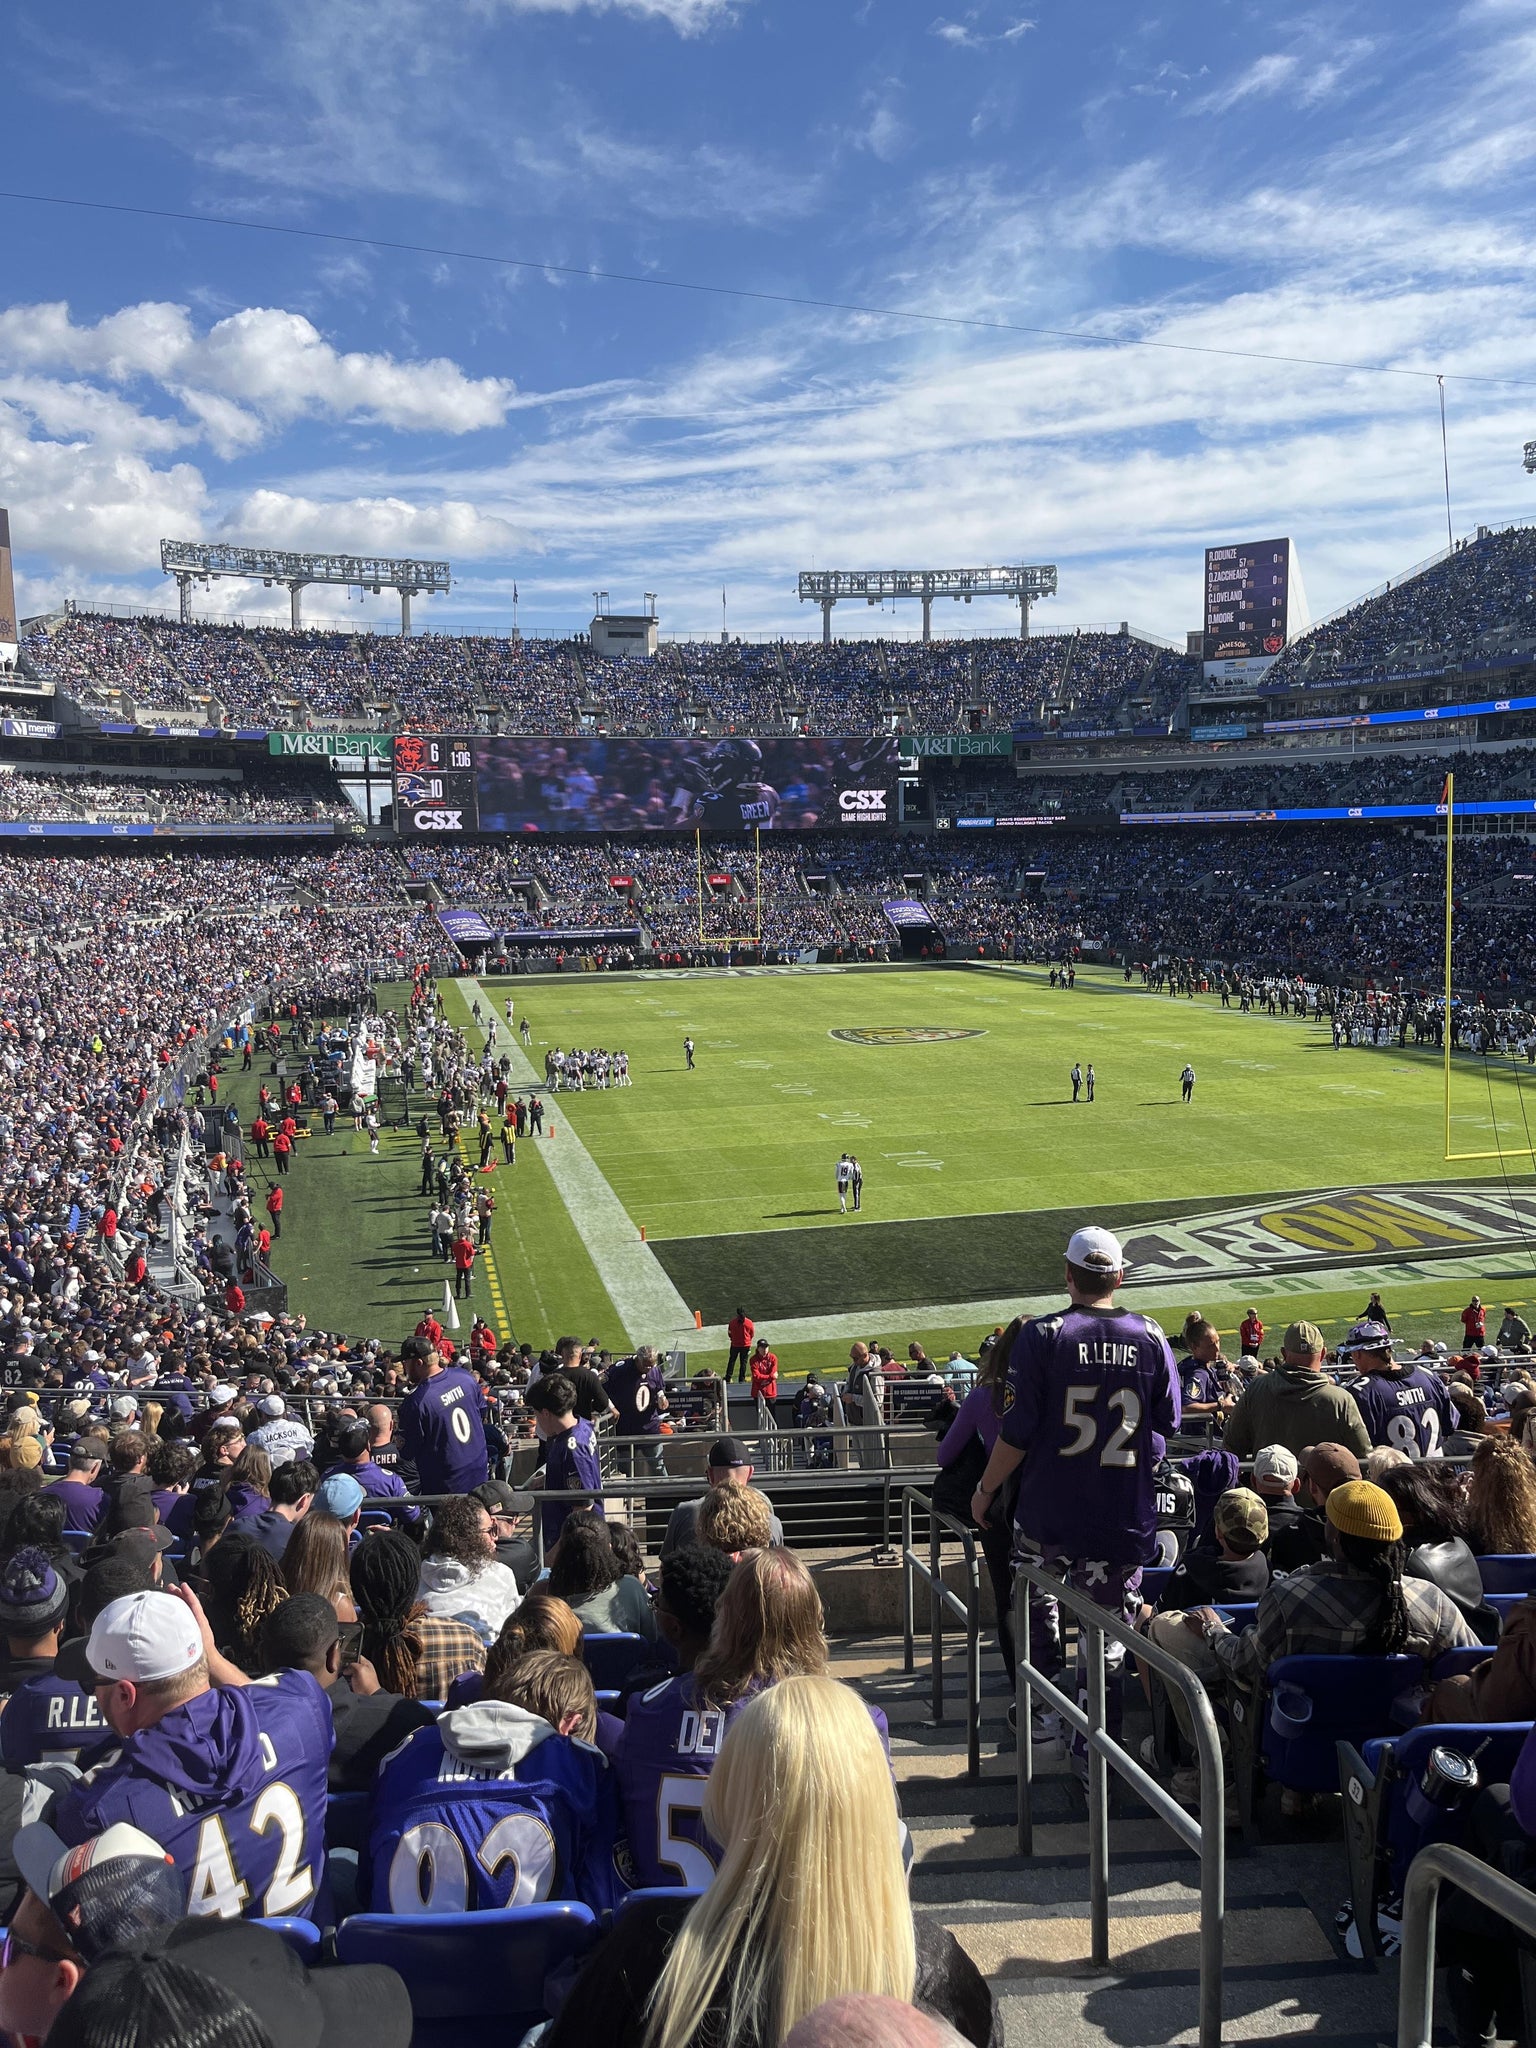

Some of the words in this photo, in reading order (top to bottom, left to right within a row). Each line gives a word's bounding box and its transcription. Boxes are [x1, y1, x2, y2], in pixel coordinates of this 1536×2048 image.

[1239, 558, 1246, 567] 57
[1208, 612, 1234, 624] D.MOORE
[1218, 641, 1246, 650] JAMESON
[1424, 709, 1438, 718] CSX
[1495, 701, 1510, 710] CSX
[29, 724, 56, 734] merritt
[282, 734, 333, 755] M&T
[335, 736, 382, 756] Bank
[431, 743, 439, 762] 6
[912, 738, 957, 756] M&T
[958, 736, 1001, 754] Bank
[451, 752, 470, 766] 1:06
[430, 779, 442, 798] 10
[839, 790, 886, 809] CSX
[414, 810, 462, 829] CSX
[740, 802, 770, 820] GREEN
[841, 812, 856, 822] GAME
[857, 812, 886, 822] HIGHLIGHTS
[1348, 808, 1362, 816] CSX
[28, 825, 43, 834] CSX
[112, 825, 127, 834] CSX
[817, 1111, 872, 1128] 20
[880, 1150, 944, 1171] 10
[841, 1166, 848, 1176] 19
[1345, 1266, 1426, 1286] OF
[1229, 1277, 1324, 1295] US
[1078, 1343, 1138, 1367] R.LEWIS
[4, 1369, 22, 1385] 82
[440, 1385, 464, 1407] SMITH
[636, 1386, 650, 1412] 0
[1396, 1387, 1426, 1406] SMITH
[452, 1407, 471, 1443] 0
[1058, 1385, 1142, 1468] 52
[1387, 1407, 1444, 1457] 82
[265, 1430, 298, 1443] JACKSON
[568, 1436, 577, 1450] 8
[48, 1696, 108, 1728] R.LE
[1352, 1782, 1359, 1799] 32
[186, 1781, 315, 1919] 42
